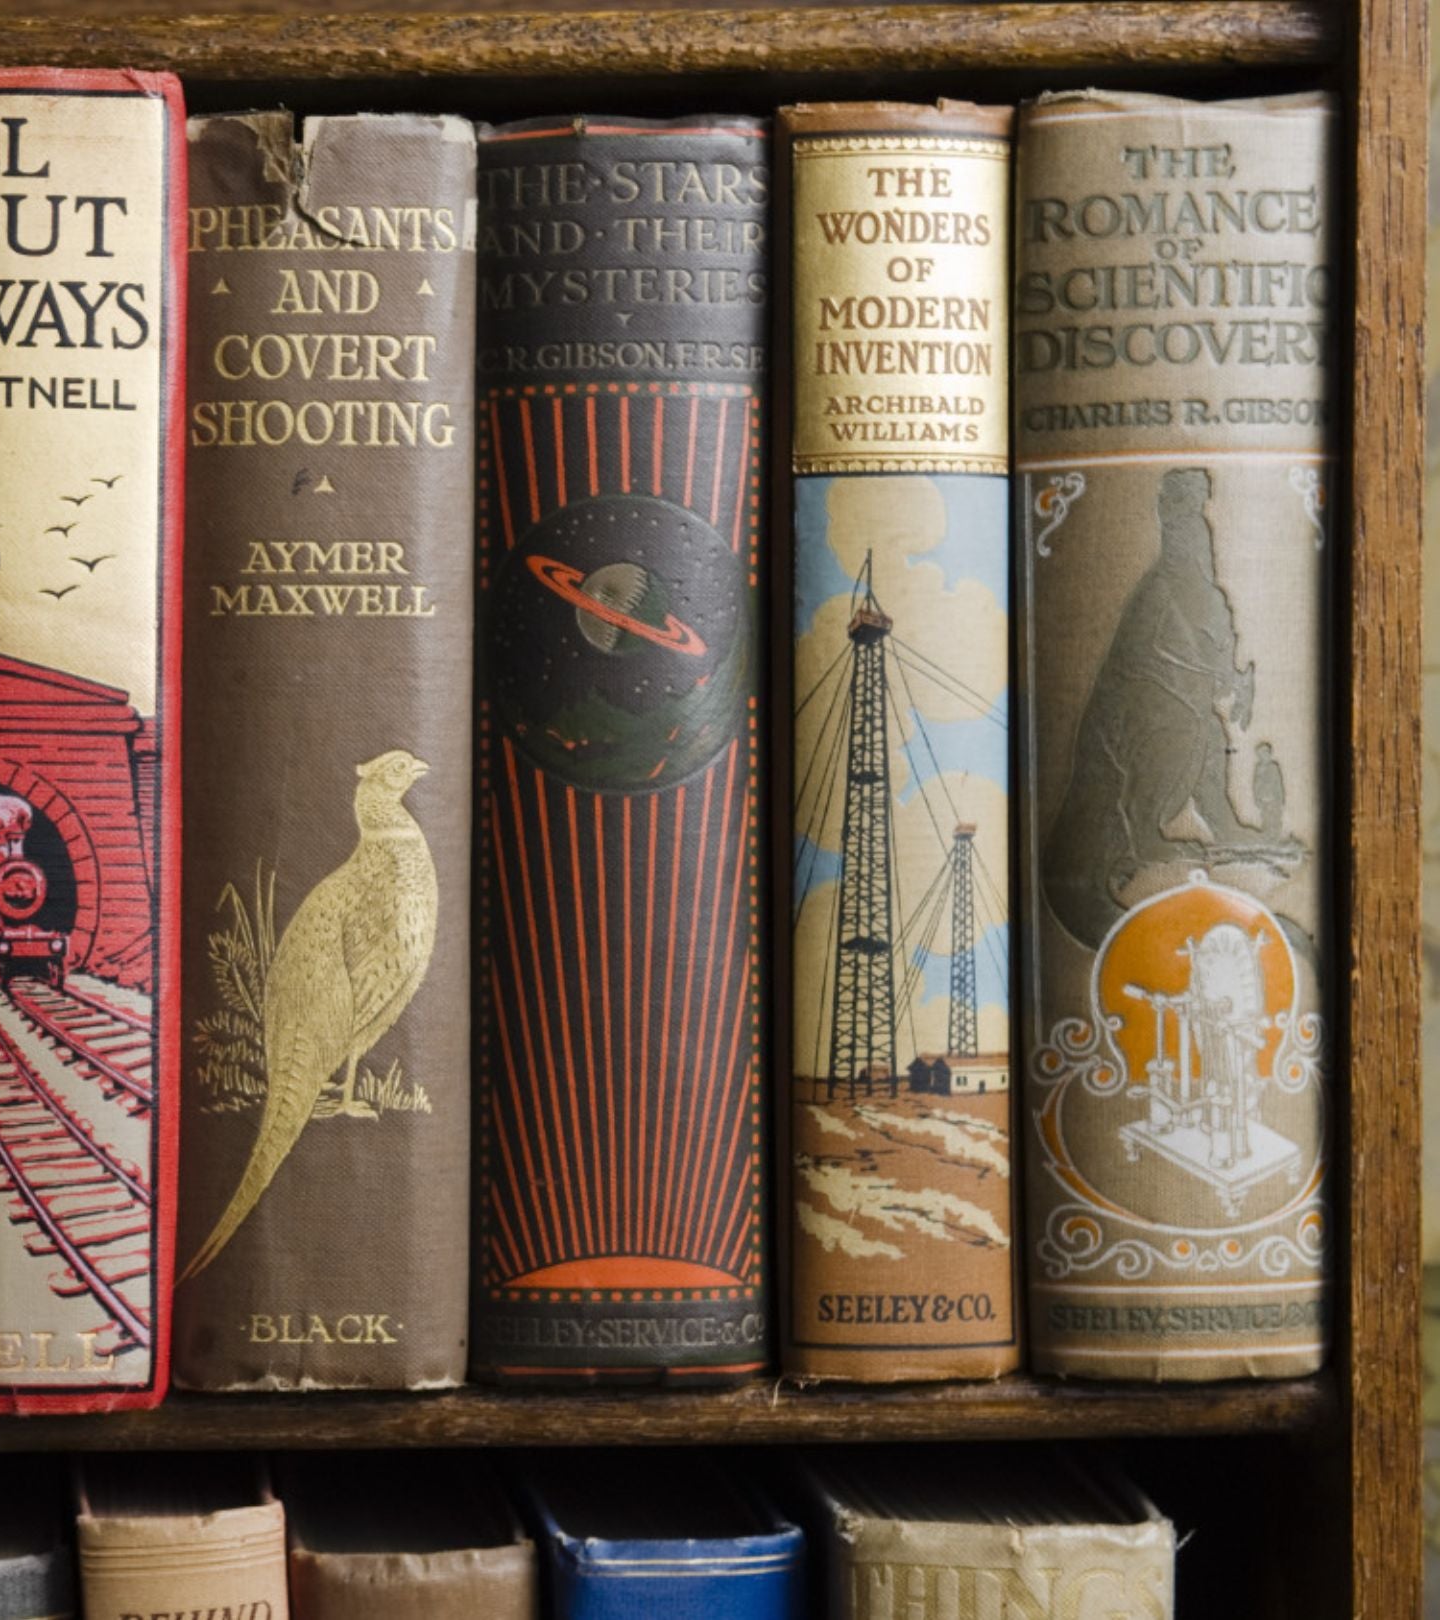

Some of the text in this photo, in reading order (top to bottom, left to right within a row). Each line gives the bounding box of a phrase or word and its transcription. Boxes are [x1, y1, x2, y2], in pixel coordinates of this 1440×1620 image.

[1122, 145, 1235, 179] THE
[866, 166, 953, 198] THE
[189, 204, 458, 253] PHEASANTS
[815, 211, 992, 246] WONDERS
[1024, 187, 1321, 244] ROMANCE
[1154, 238, 1205, 260] OF
[886, 256, 935, 283] OF
[270, 269, 380, 315] AND
[480, 267, 767, 310] MYSTERIES
[817, 296, 992, 331] MODERN
[213, 333, 438, 382] COVERT
[815, 340, 992, 376] INVENTION
[823, 395, 985, 416] ARCHIBALD
[1022, 400, 1173, 432] CHARLES
[191, 400, 456, 448] SHOOTING
[829, 422, 979, 442] WILLIAMS
[241, 541, 411, 575] AYMER
[210, 584, 436, 617] MAXWELL
